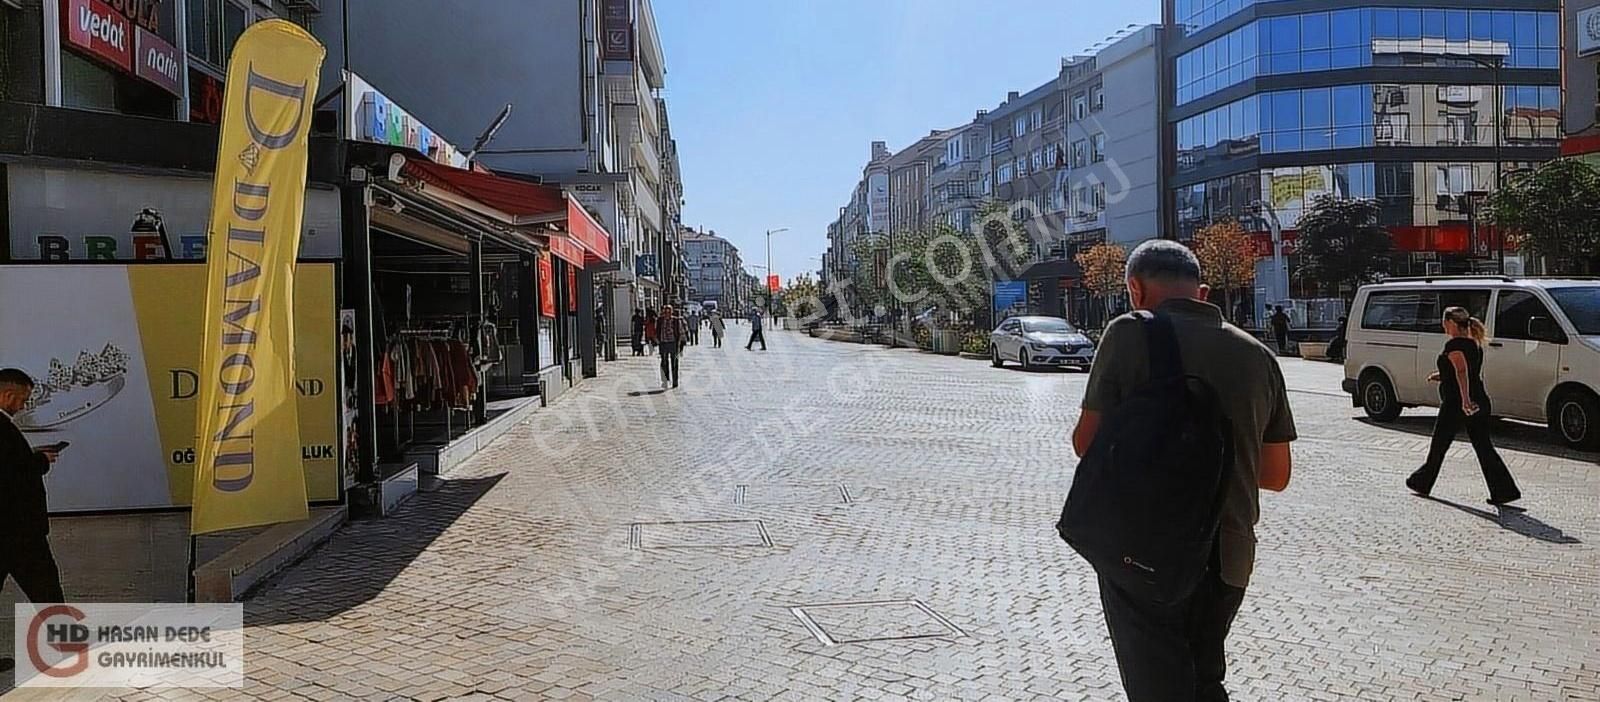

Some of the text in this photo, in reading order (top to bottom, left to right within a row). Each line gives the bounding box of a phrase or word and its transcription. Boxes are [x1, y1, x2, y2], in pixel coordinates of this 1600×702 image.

[79, 6, 125, 51] vedat
[147, 48, 178, 82] narin
[213, 60, 307, 492] D DIAMOND
[302, 446, 333, 460] LUK
